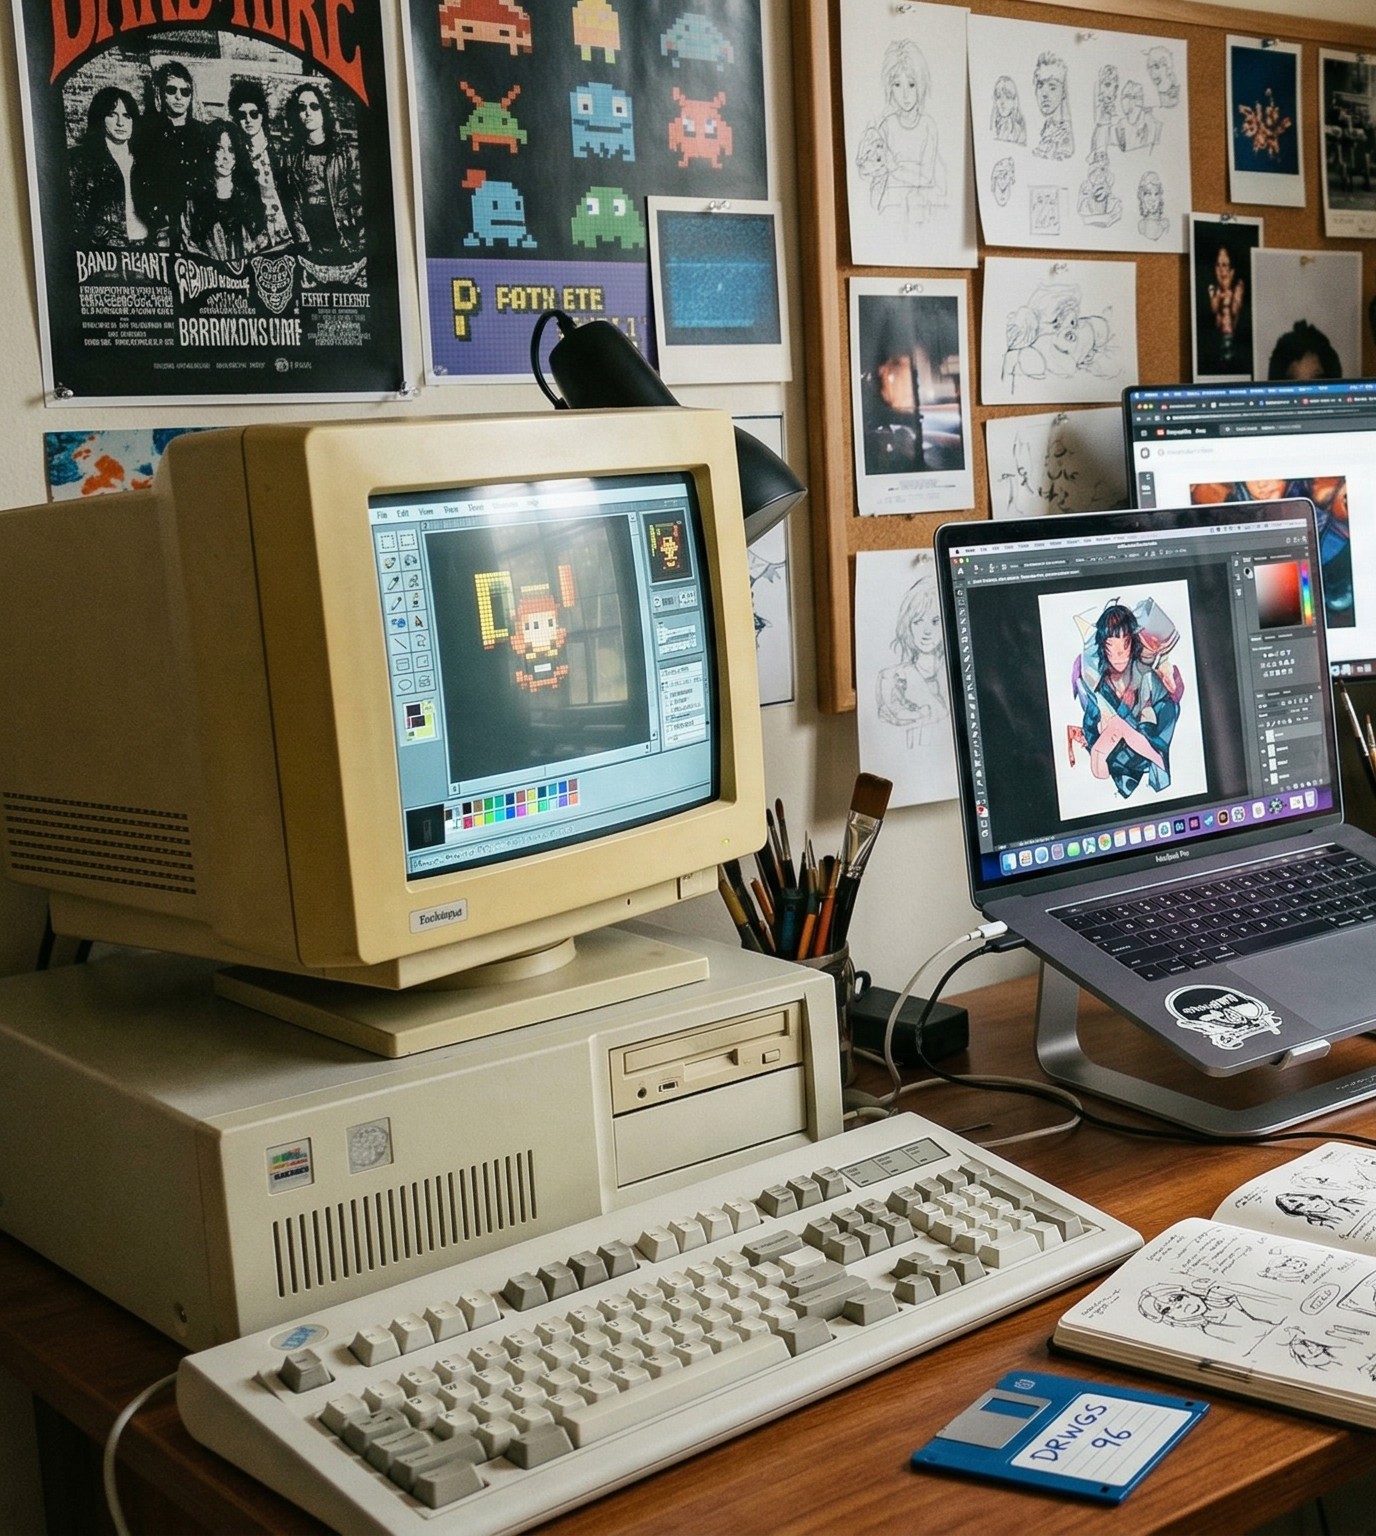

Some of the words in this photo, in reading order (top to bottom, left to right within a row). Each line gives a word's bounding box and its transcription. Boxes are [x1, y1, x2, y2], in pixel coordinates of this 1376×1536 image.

[76, 251, 118, 283] BAND
[1029, 1403, 1108, 1463] DRWGS
[1091, 1427, 1132, 1449] 96
